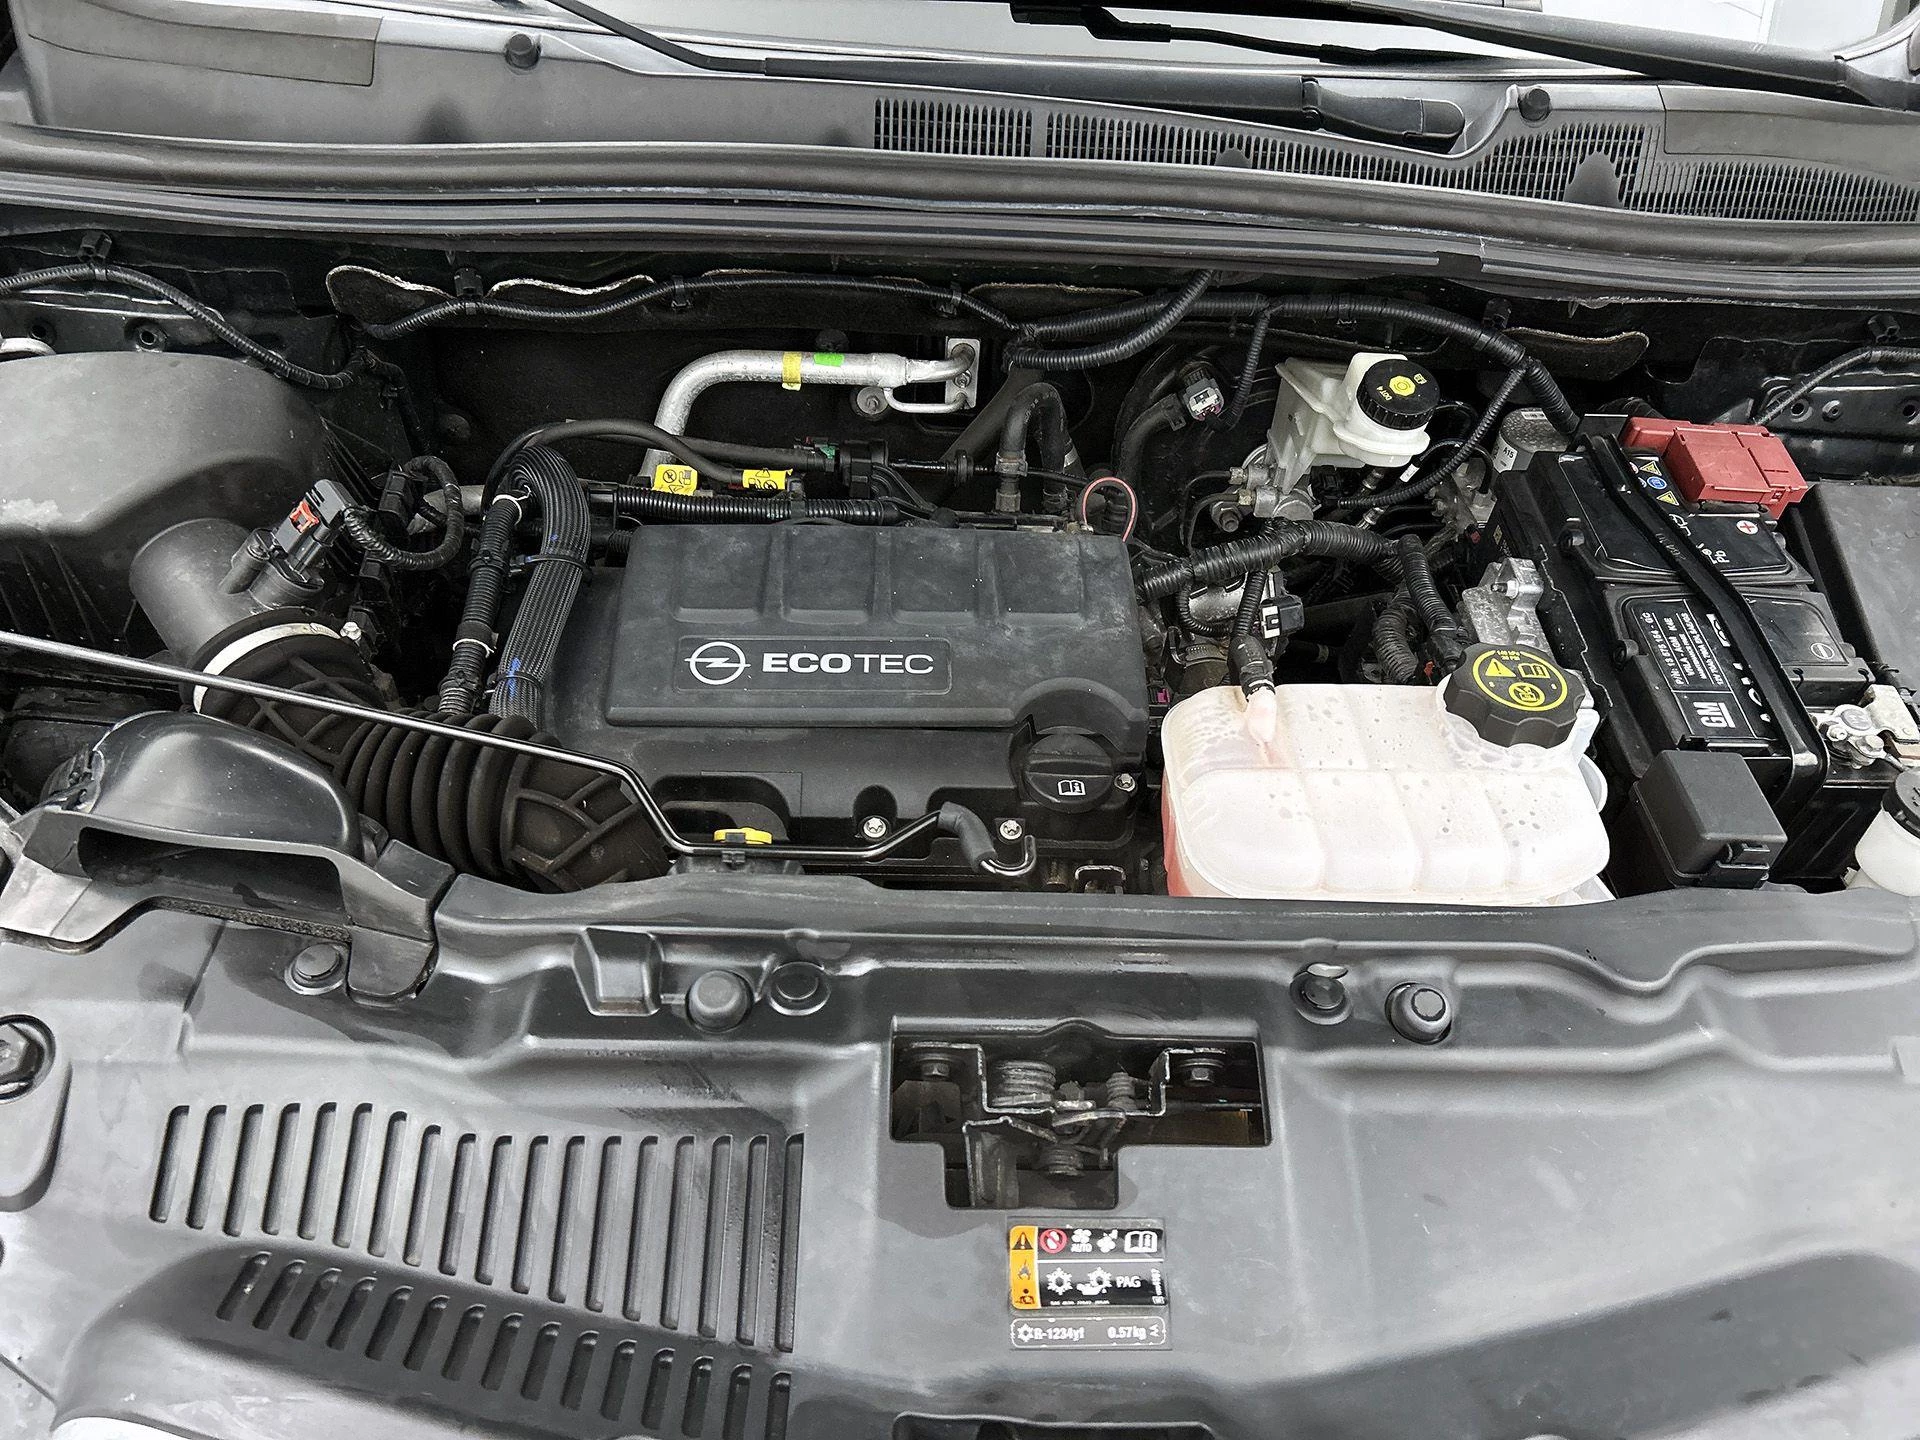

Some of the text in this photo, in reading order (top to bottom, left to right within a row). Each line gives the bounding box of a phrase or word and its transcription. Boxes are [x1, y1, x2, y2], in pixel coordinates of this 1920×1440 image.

[1380, 390, 1392, 400] DOT
[1715, 550, 1730, 562] Pb
[1668, 636, 1684, 652] AGM
[762, 653, 934, 674] ECOTEC
[1665, 658, 1675, 666] 13
[1680, 657, 1695, 676] VRLA
[1671, 668, 1684, 685] P/N:
[1693, 702, 1728, 728] GM
[1071, 1243, 1092, 1253] AUTO
[1116, 1276, 1141, 1288] PAG
[1034, 1326, 1085, 1341] R-1234yf
